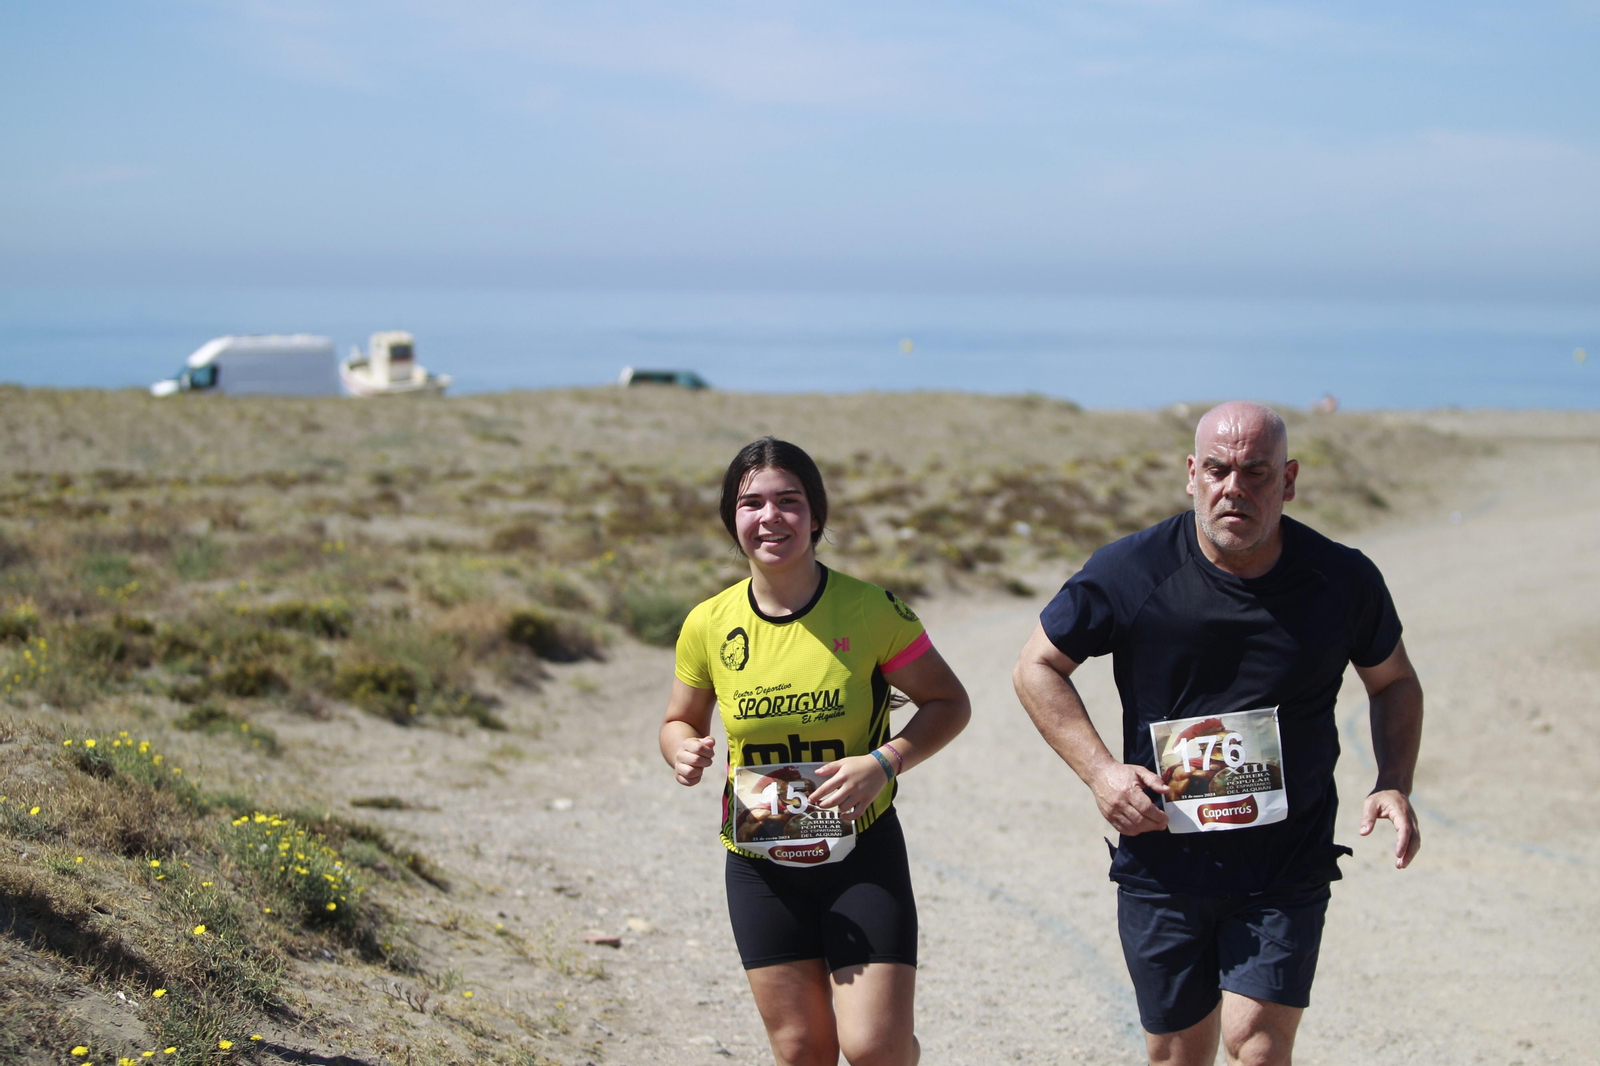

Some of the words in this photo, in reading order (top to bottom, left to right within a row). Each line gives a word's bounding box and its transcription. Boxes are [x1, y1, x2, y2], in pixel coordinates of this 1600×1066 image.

[733, 690, 753, 700] Centro
[755, 683, 792, 695] Deportivo
[738, 689, 840, 719] SPORTGYM
[801, 714, 812, 724] El
[1173, 732, 1246, 773] 176
[1226, 772, 1270, 781] CARRERA
[1226, 777, 1270, 786] POPULAR
[801, 810, 841, 820] XIII
